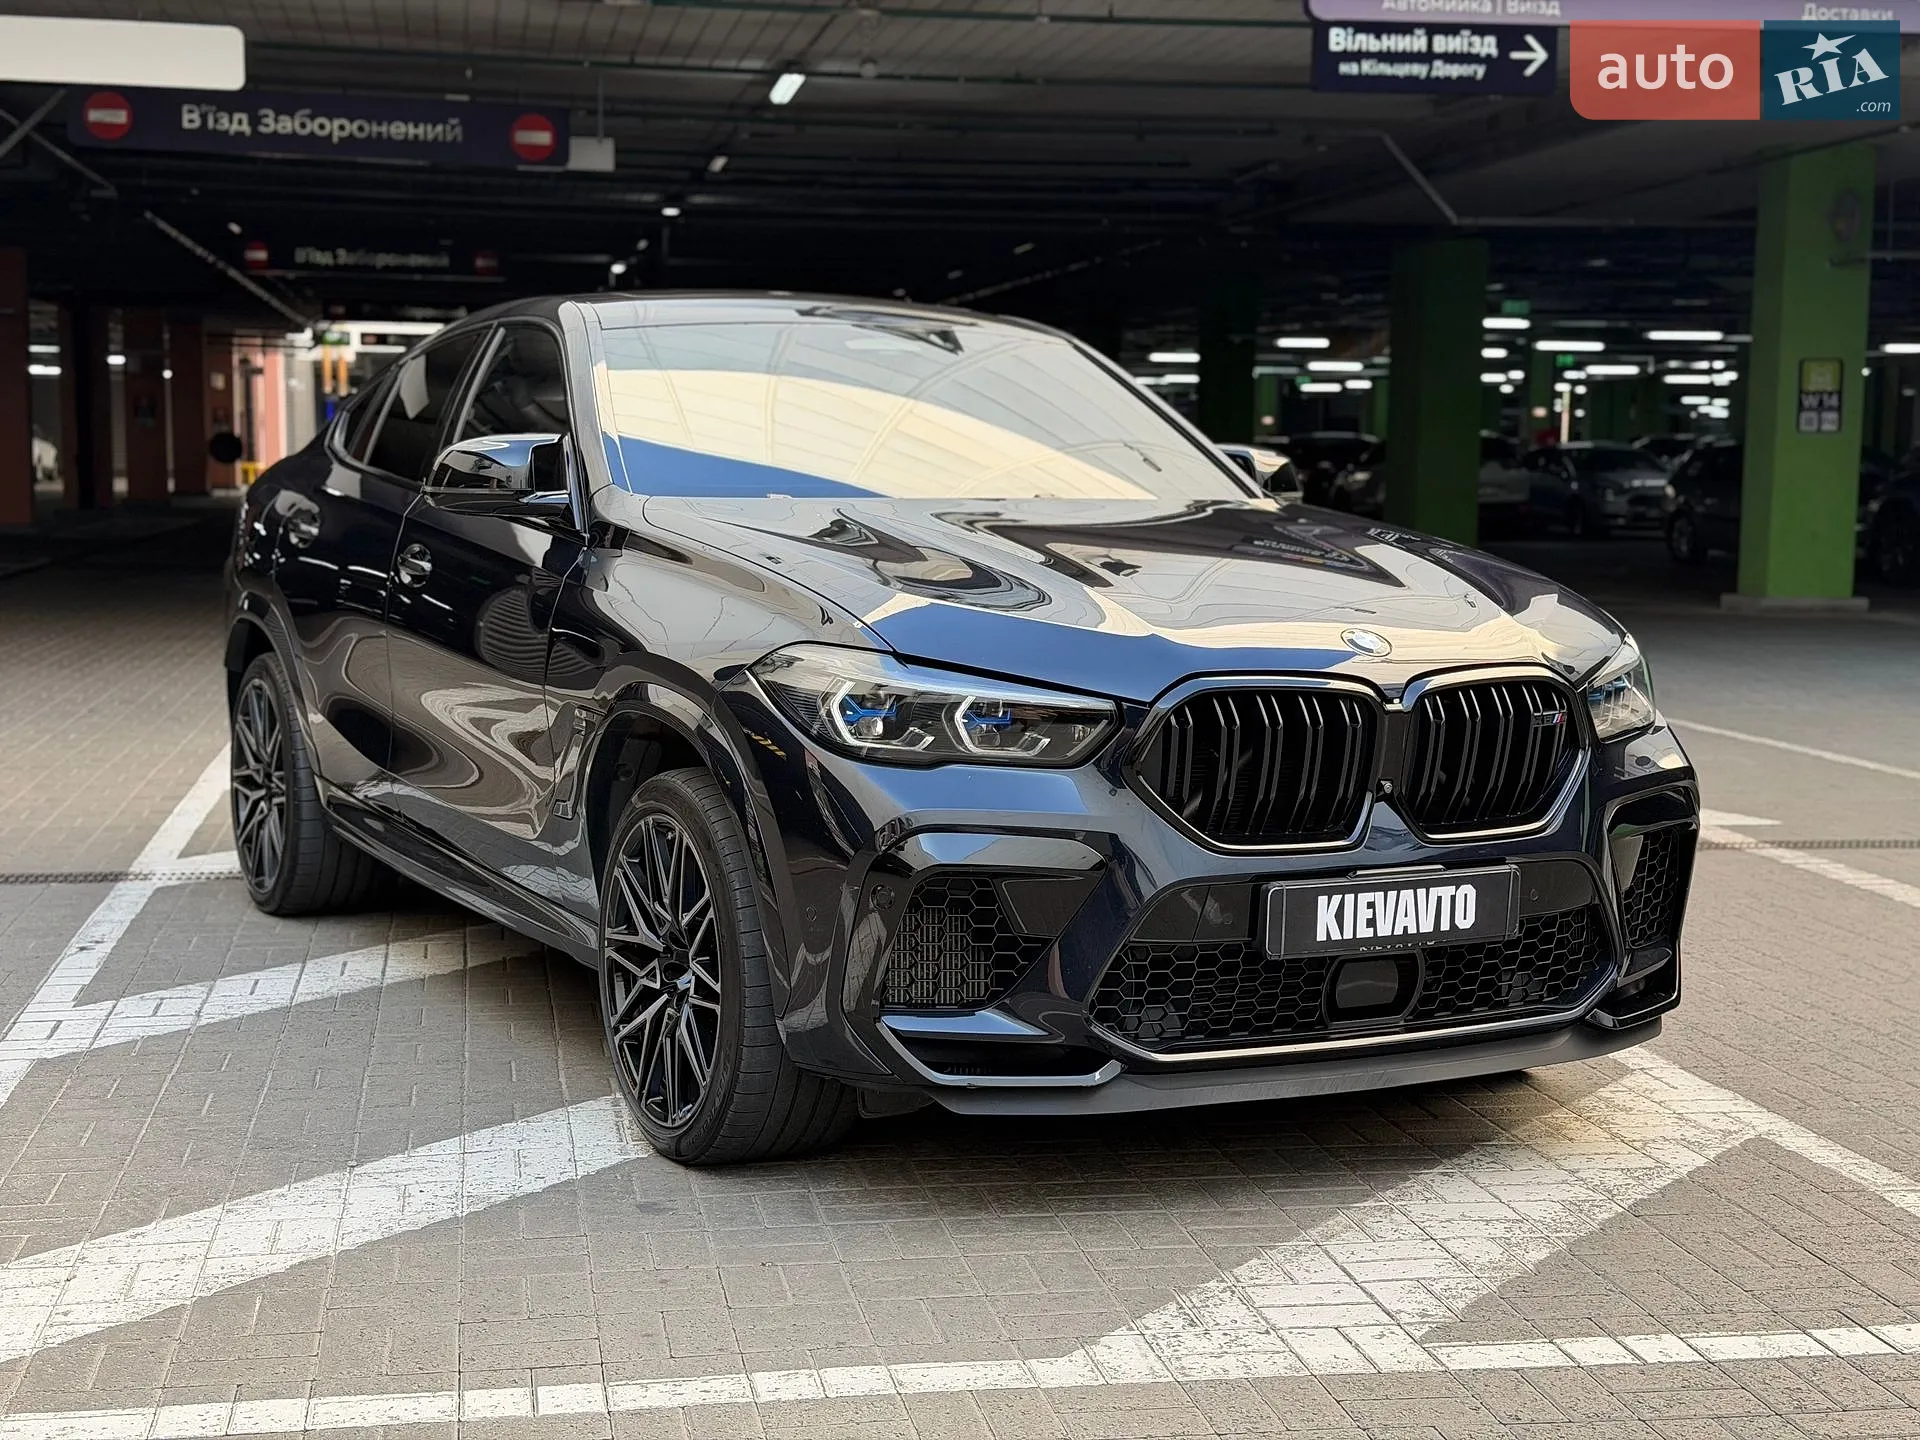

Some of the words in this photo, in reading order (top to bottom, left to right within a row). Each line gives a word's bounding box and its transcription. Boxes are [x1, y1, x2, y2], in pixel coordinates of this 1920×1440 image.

[1801, 3, 1894, 20] Доставки
[1328, 26, 1428, 53] Вільний
[1432, 29, 1499, 58] виїзд
[257, 108, 463, 144] Заборонений
[1316, 884, 1477, 942] KIEVAVTO
